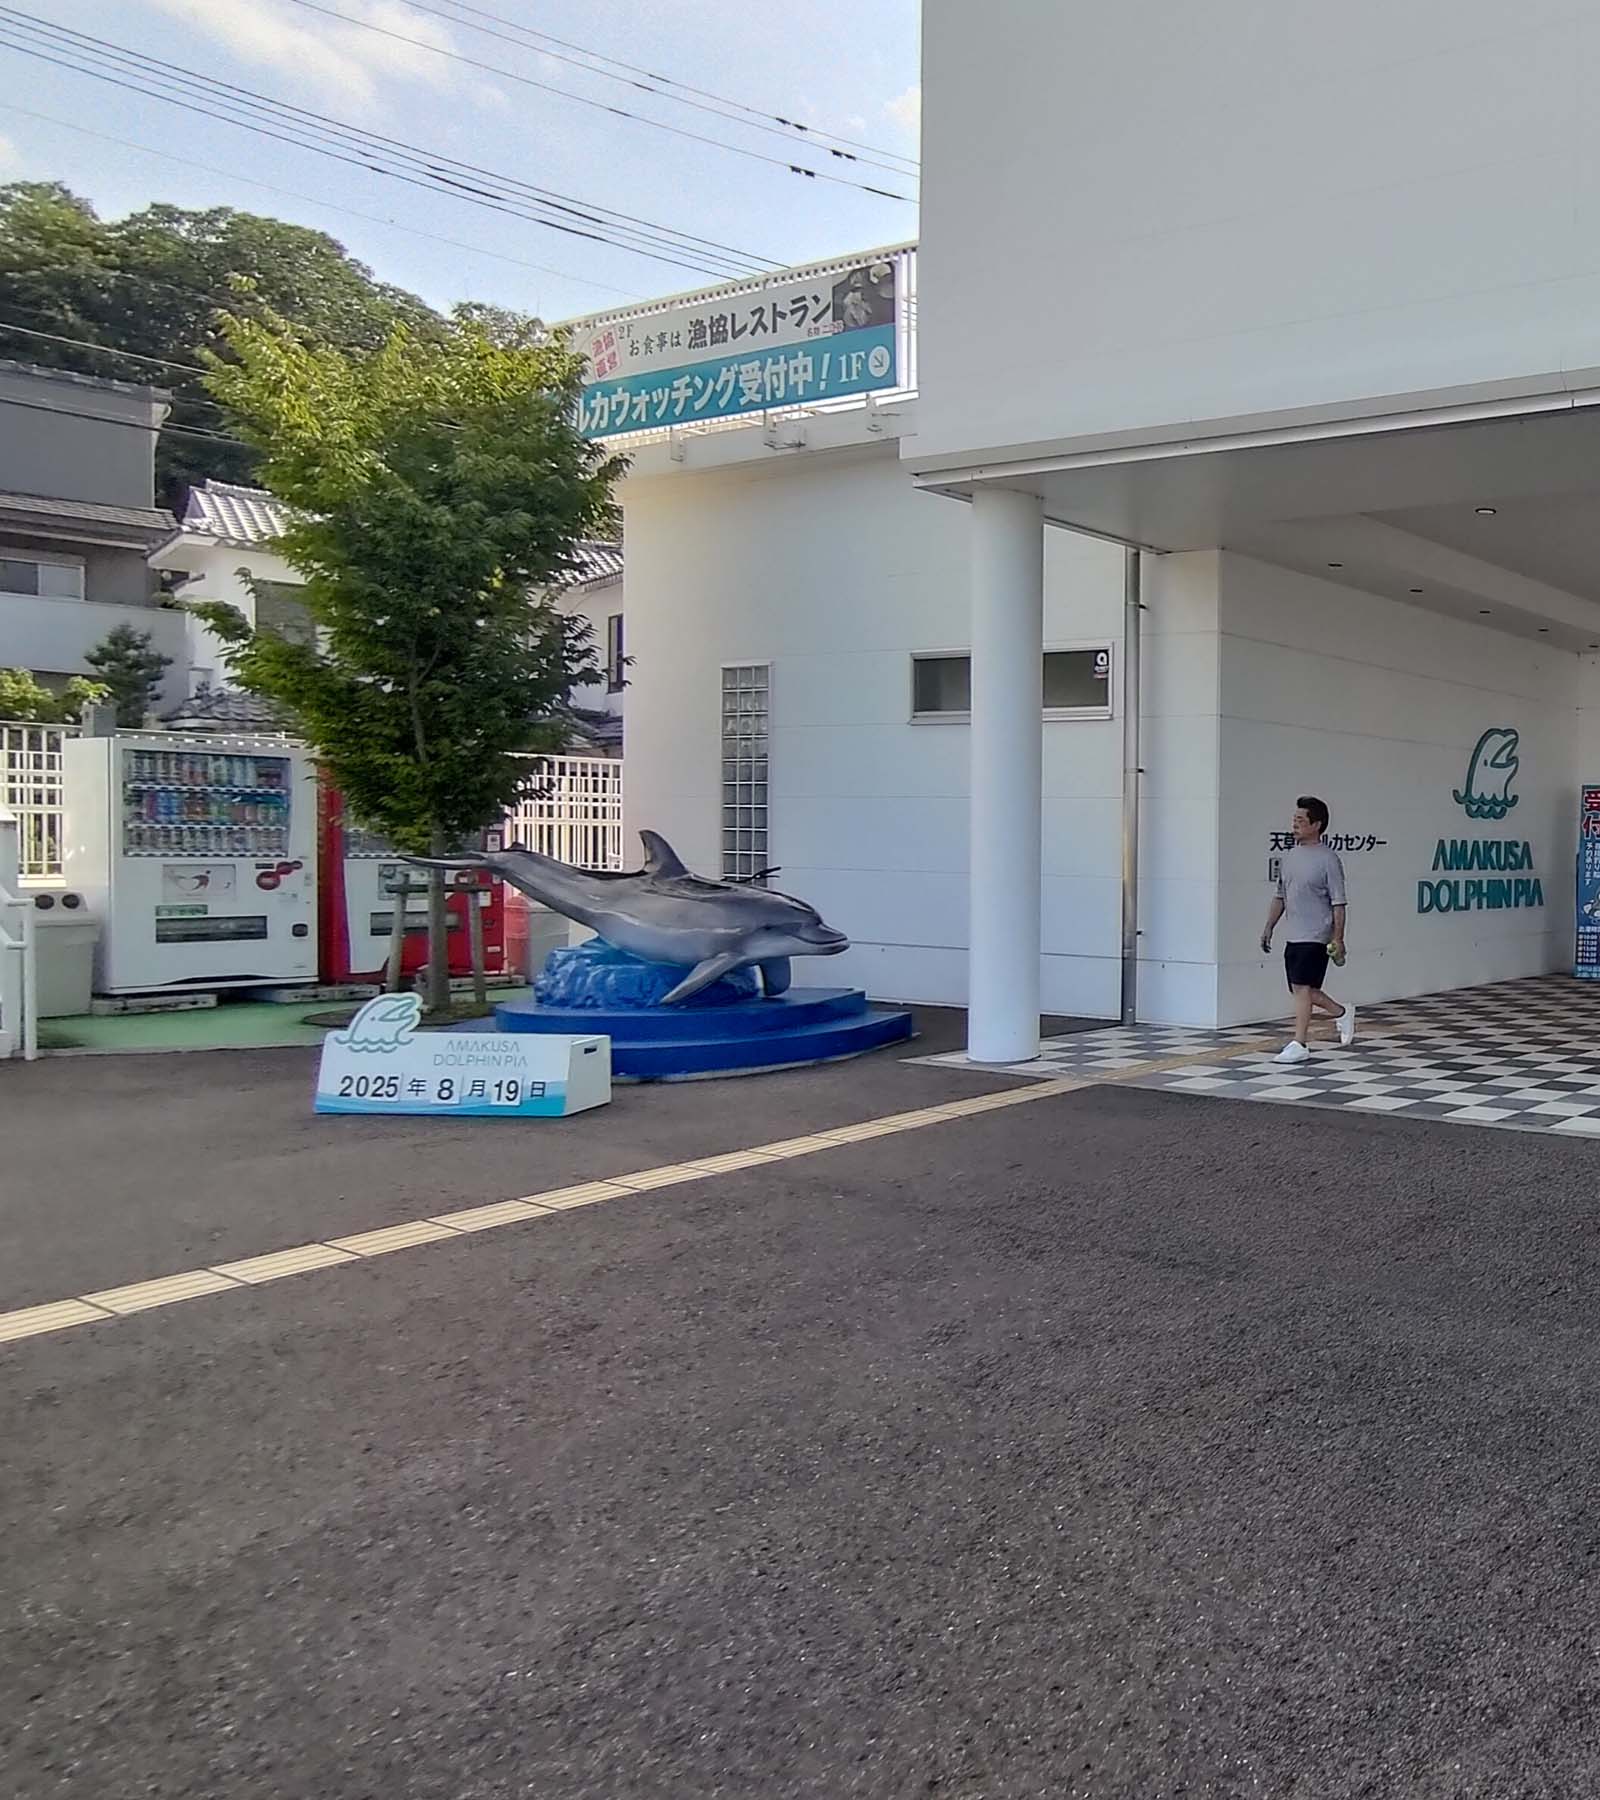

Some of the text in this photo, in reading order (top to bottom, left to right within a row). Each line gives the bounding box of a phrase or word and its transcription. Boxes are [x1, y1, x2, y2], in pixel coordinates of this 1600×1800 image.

[618, 324, 634, 340] 2F
[628, 332, 682, 357] お食事は
[687, 294, 832, 350] 漁協レストラン
[838, 352, 866, 383] 1F
[1269, 832, 1388, 852] 天草ルカセンター
[1431, 838, 1534, 871] AMAKUSA
[446, 1039, 520, 1053] AMAKUSA
